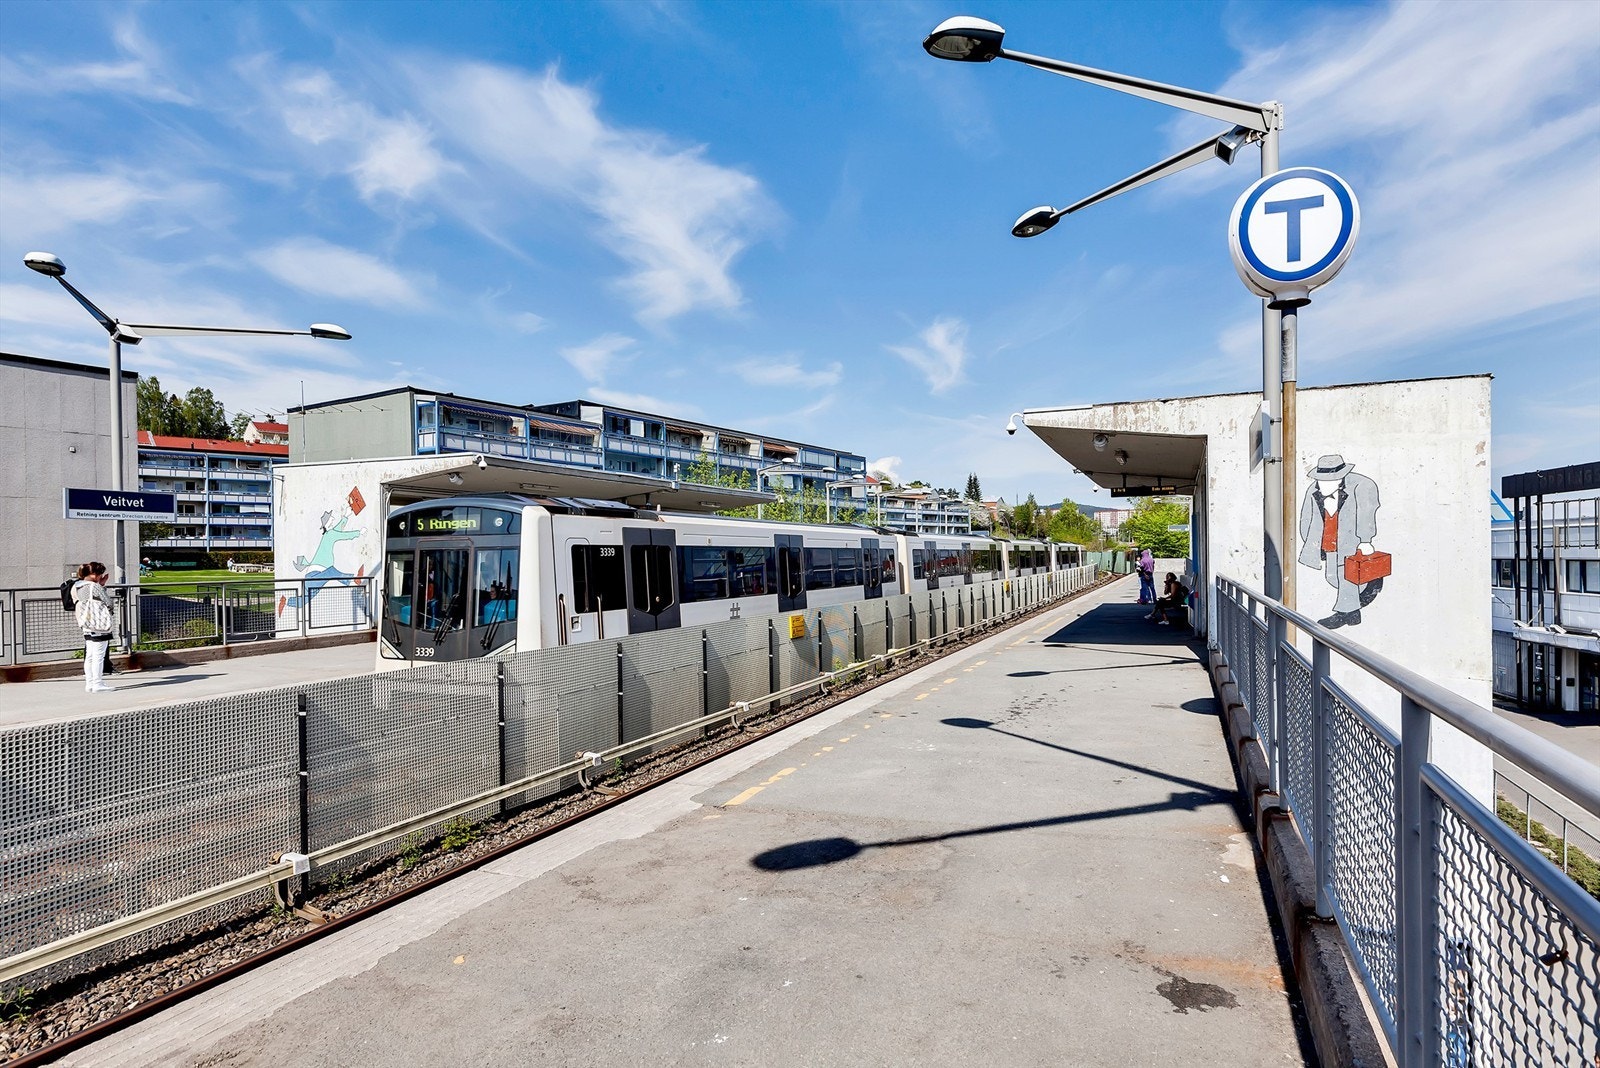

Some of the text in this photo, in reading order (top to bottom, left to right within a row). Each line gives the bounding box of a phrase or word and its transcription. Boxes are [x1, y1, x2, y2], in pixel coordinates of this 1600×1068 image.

[1264, 194, 1325, 263] T
[103, 495, 144, 508] Veitvet
[76, 511, 98, 519] Retning
[417, 518, 477, 531] 5 Ringen
[600, 547, 615, 557] 3339
[415, 646, 435, 657] 3339
